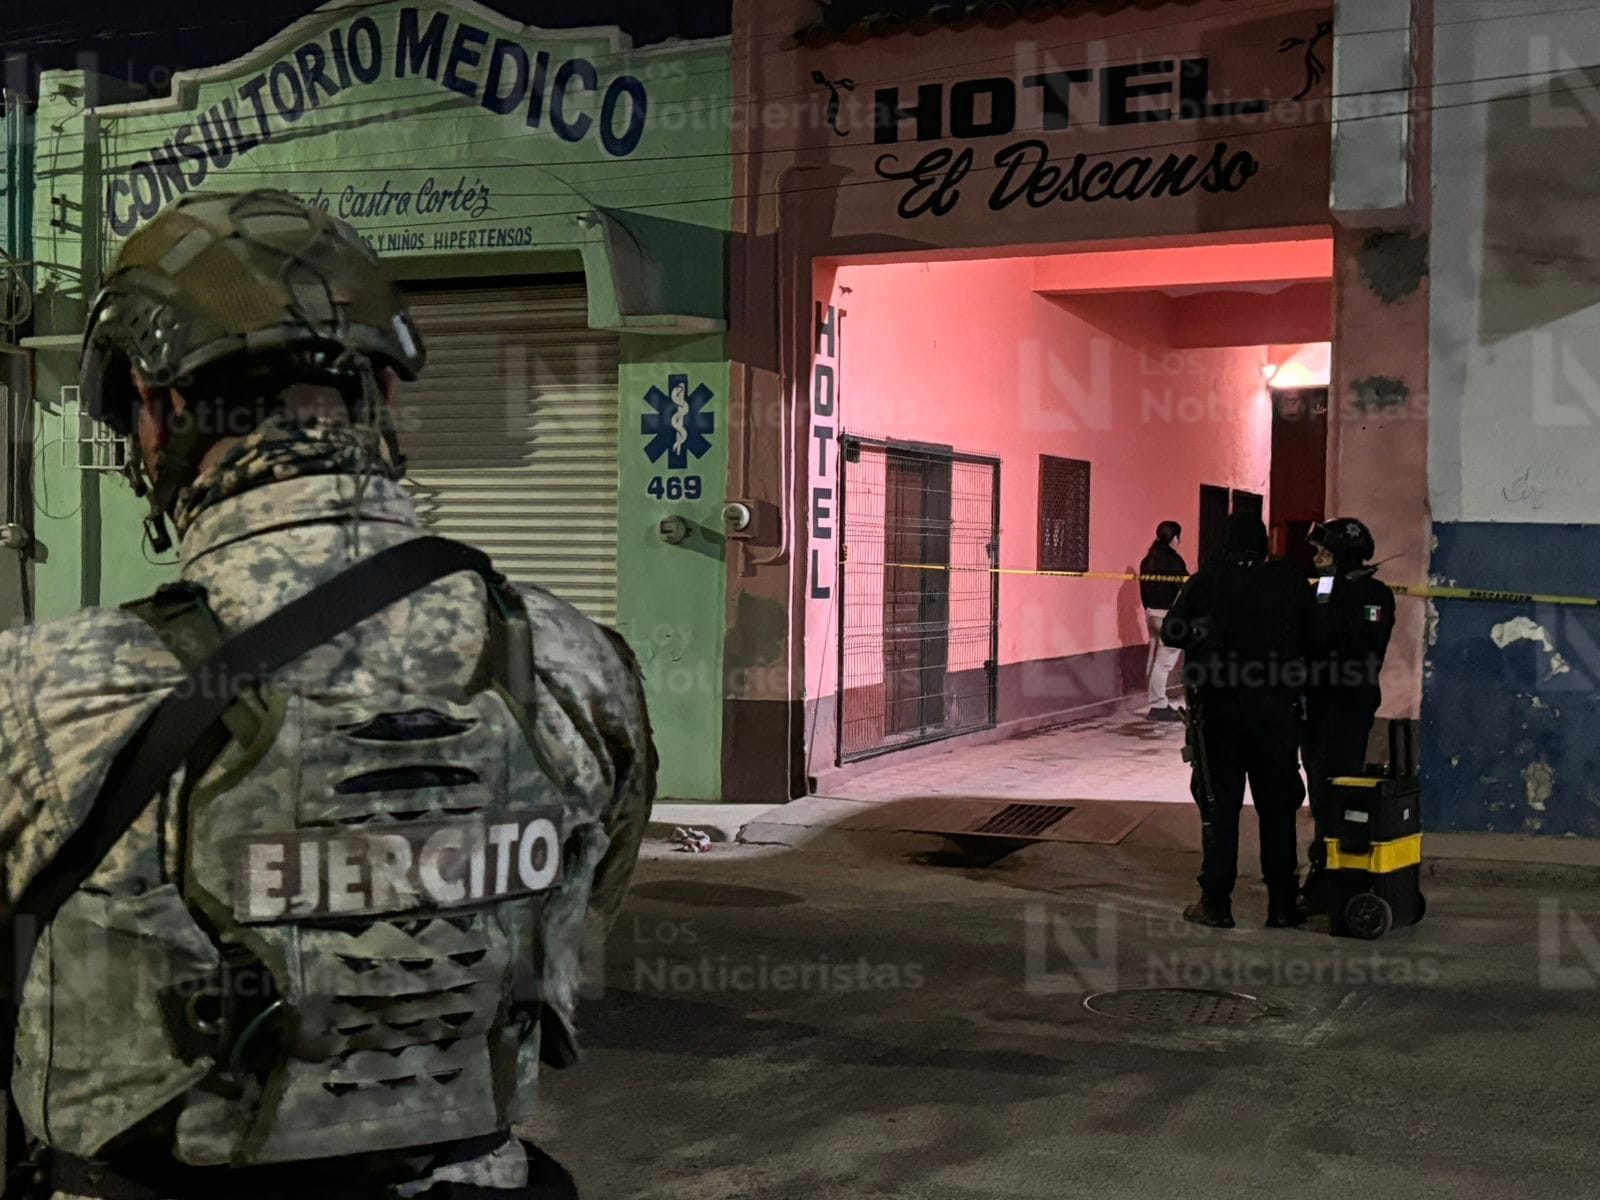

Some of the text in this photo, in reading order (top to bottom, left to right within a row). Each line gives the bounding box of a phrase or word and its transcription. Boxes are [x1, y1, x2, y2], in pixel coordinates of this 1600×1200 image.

[106, 9, 649, 237] CONSULTORIO MEDICO
[874, 58, 1270, 145] HOTEL
[875, 140, 1259, 219] El Descanso
[388, 228, 425, 251] NIÑOS
[646, 475, 703, 501] 469
[810, 301, 835, 599] HOTEL
[248, 818, 560, 918] EJERCITO
